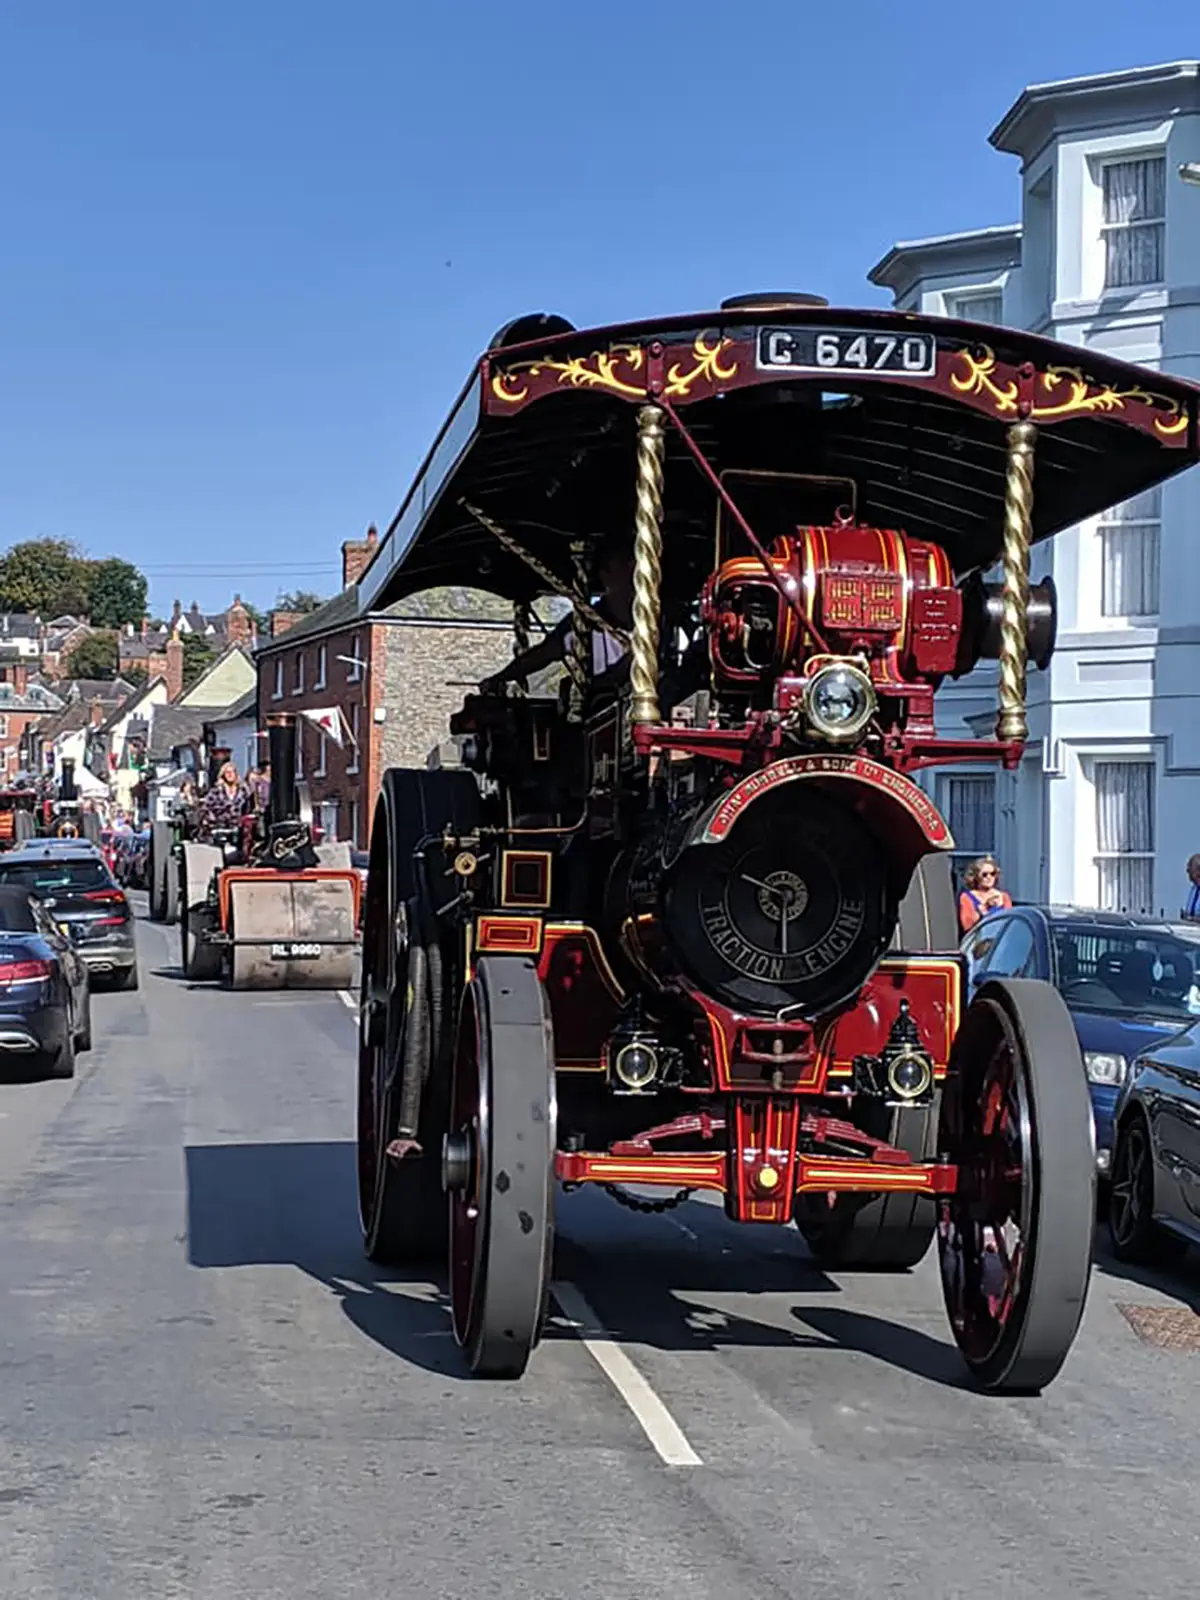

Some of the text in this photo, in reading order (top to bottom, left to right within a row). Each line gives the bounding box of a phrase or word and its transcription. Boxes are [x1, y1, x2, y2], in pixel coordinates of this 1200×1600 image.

[816, 335, 926, 370] 6470
[703, 899, 862, 980] TRACTION ENGINE
